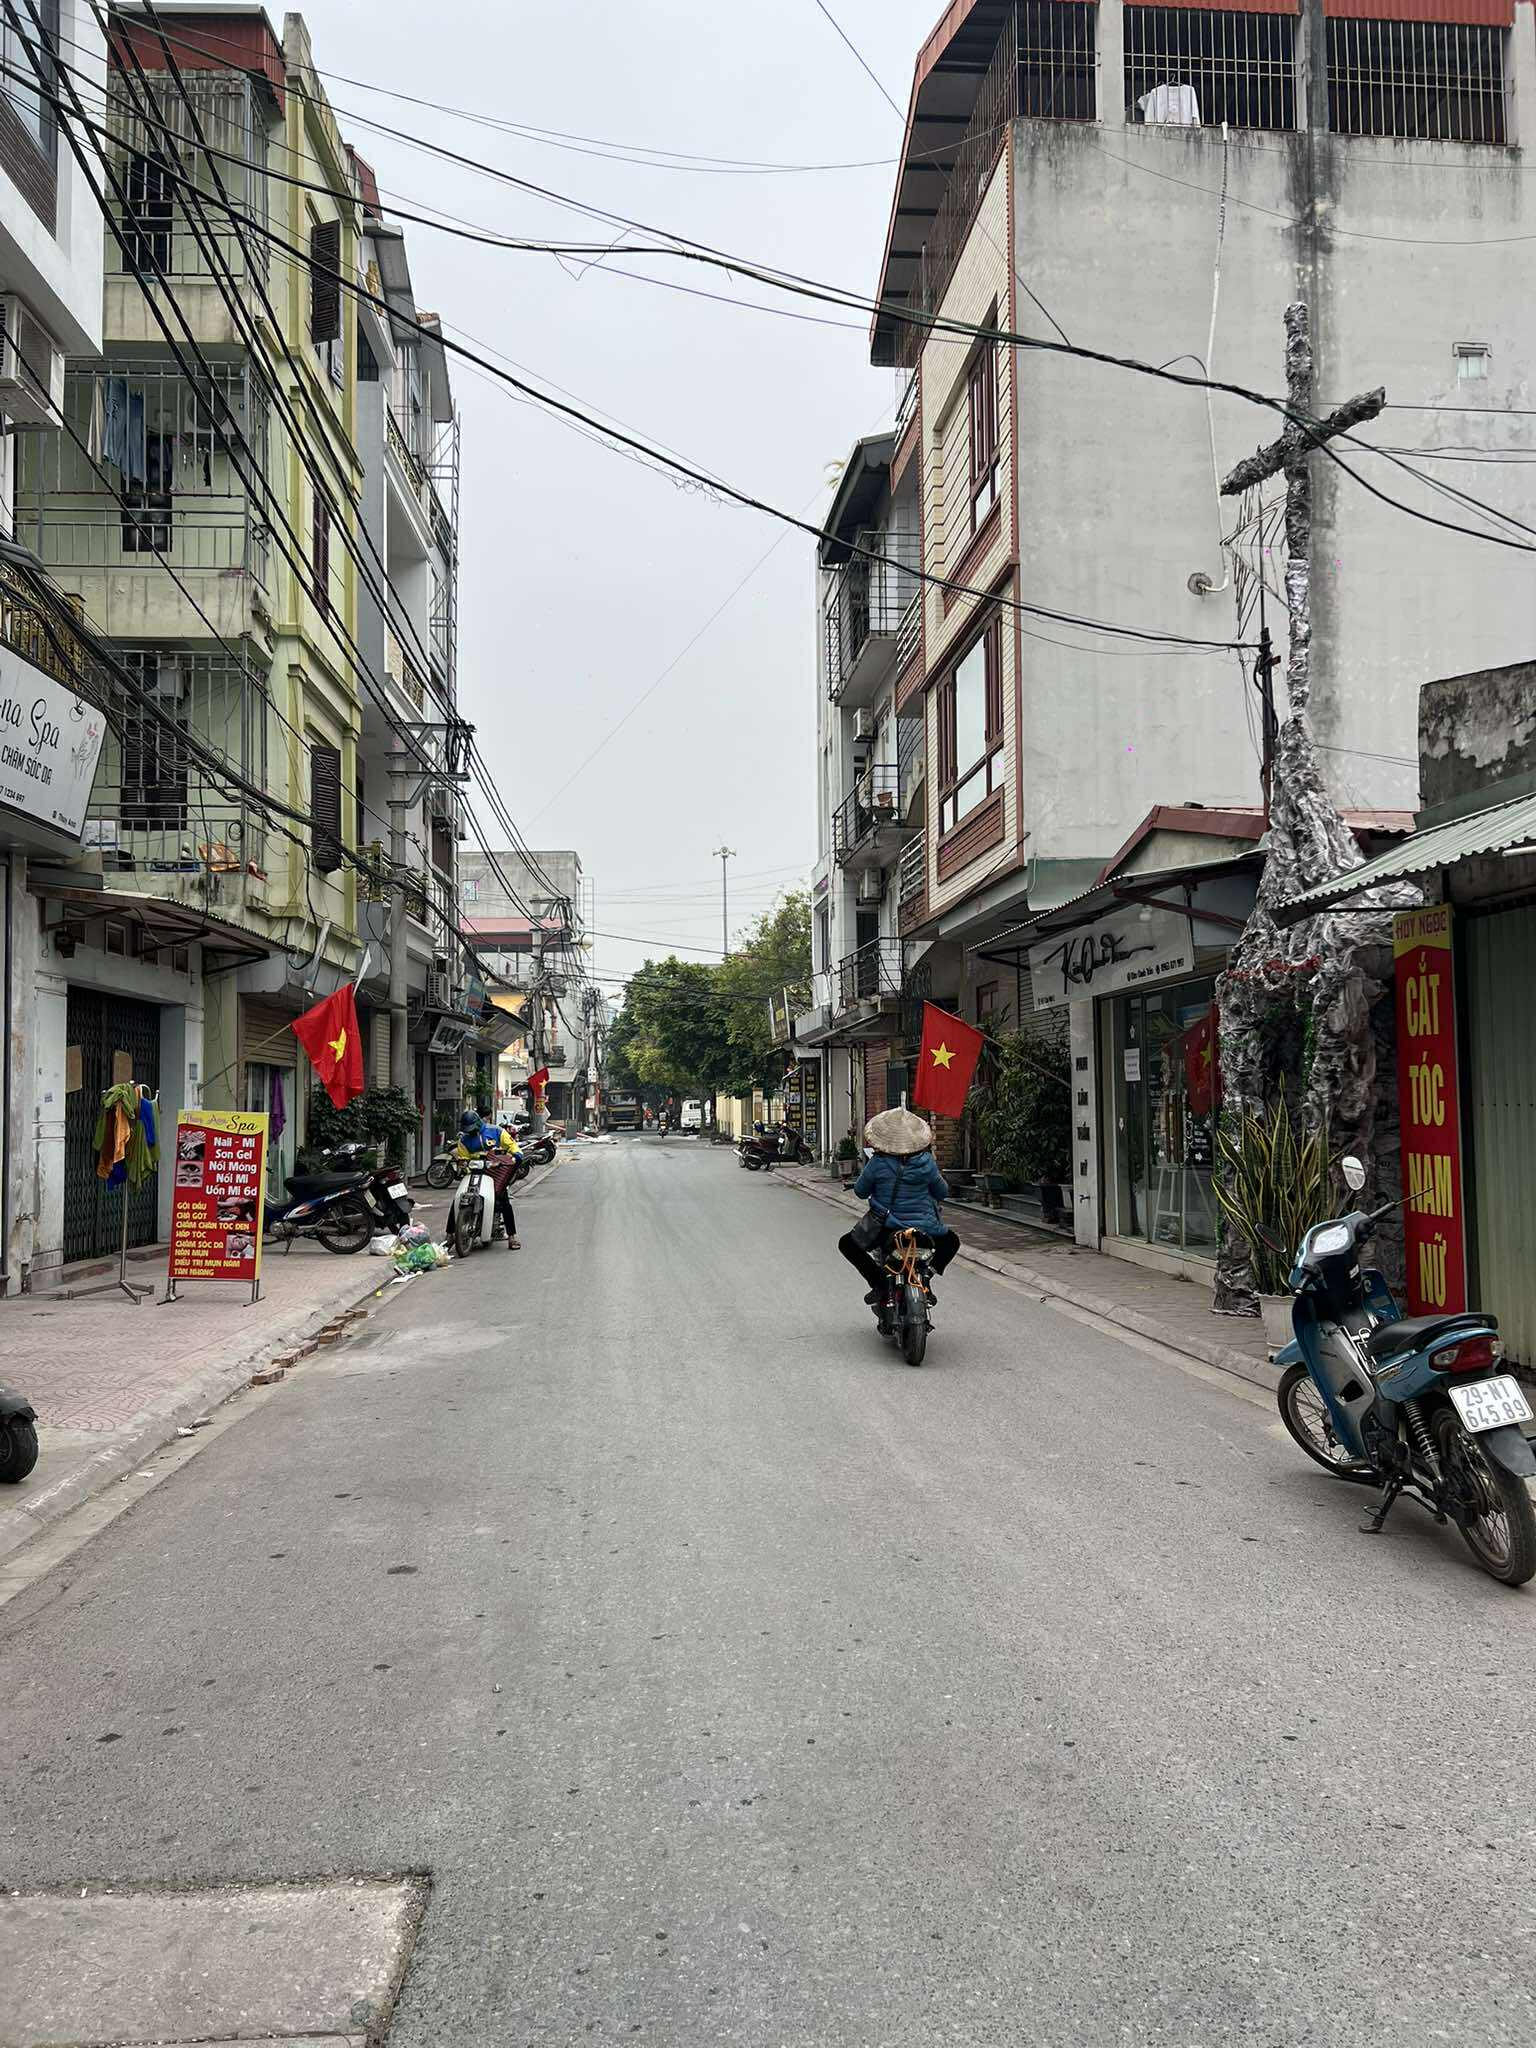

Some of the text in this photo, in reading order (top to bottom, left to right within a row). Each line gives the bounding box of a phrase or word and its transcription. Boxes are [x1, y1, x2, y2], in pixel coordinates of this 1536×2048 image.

[28, 698, 60, 754] Spa
[1406, 951, 1440, 1037] CẮT
[1408, 1051, 1445, 1127] TÓC
[226, 1114, 257, 1134] Spa
[213, 1136, 233, 1148] Nail
[242, 1137, 256, 1148] Mi
[236, 1149, 253, 1160] Gel
[208, 1160, 257, 1175] Nối Móng
[216, 1172, 249, 1184] Nối Mi
[205, 1184, 258, 1196] Uốn Mi 6d
[1408, 1152, 1454, 1218] NAM
[1419, 1231, 1447, 1308] NỮ
[1460, 1380, 1510, 1407] 29-N1
[1465, 1399, 1527, 1428] 645.89
